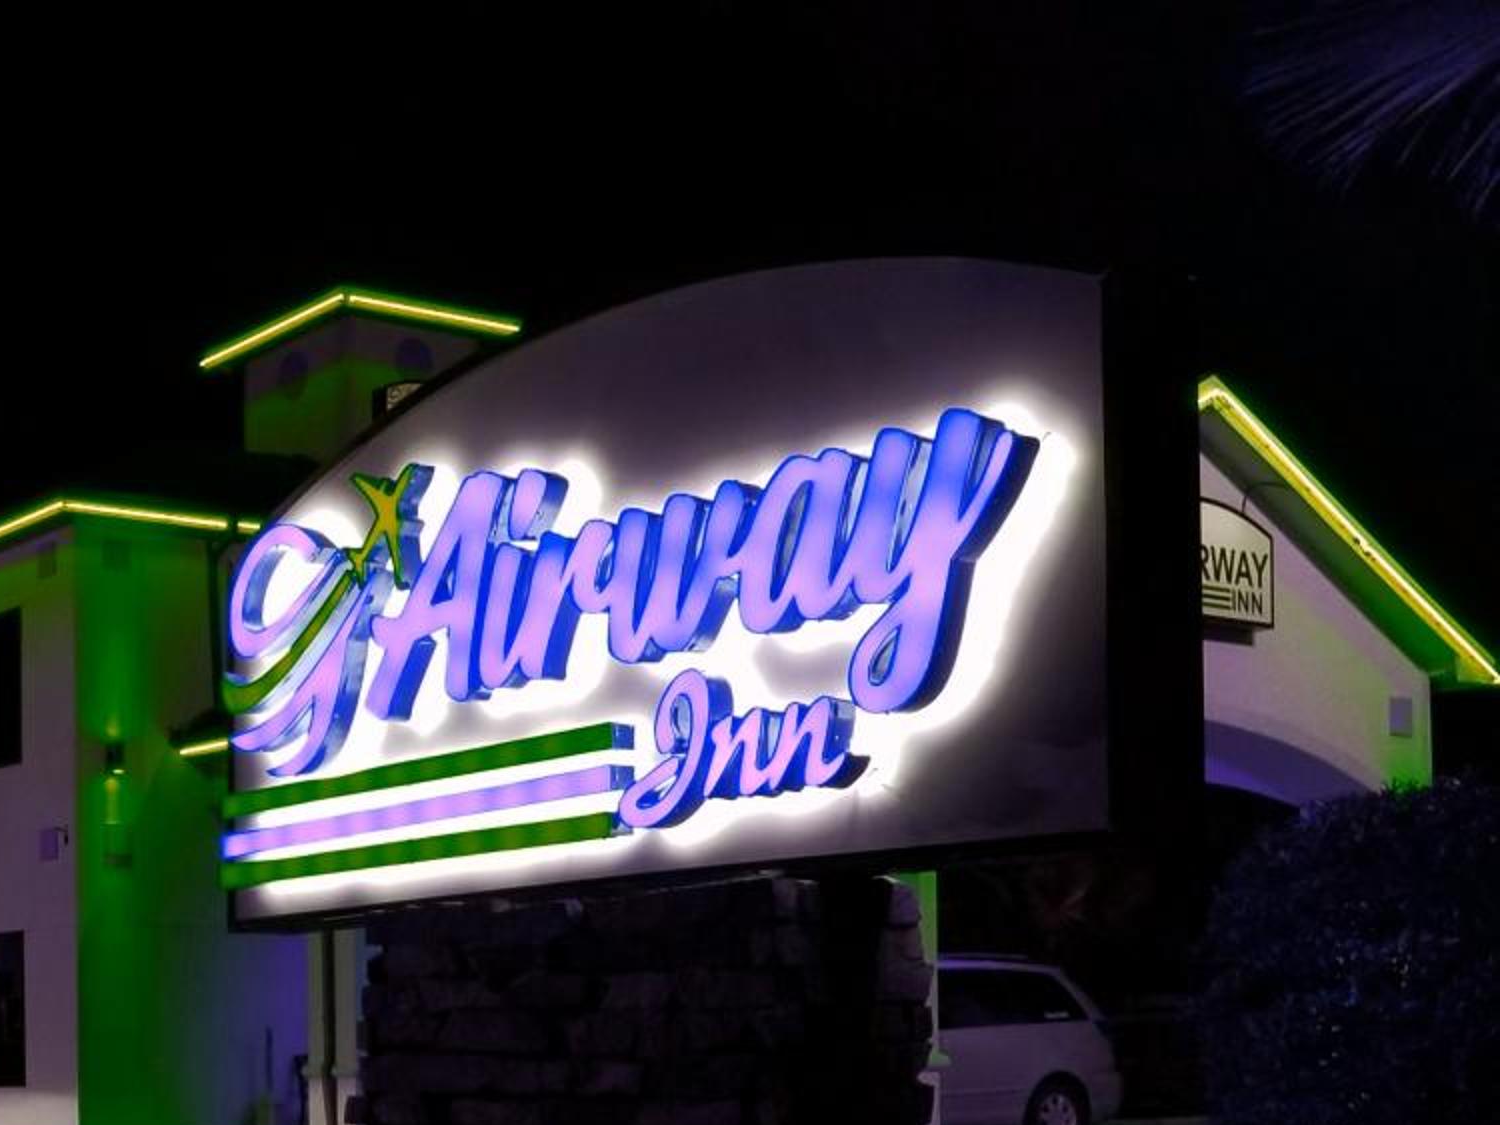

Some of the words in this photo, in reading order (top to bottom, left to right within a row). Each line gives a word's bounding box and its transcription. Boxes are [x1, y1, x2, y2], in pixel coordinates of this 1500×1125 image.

[365, 408, 1033, 721] Airway
[1231, 588, 1263, 615] INN
[618, 667, 860, 829] Inn
